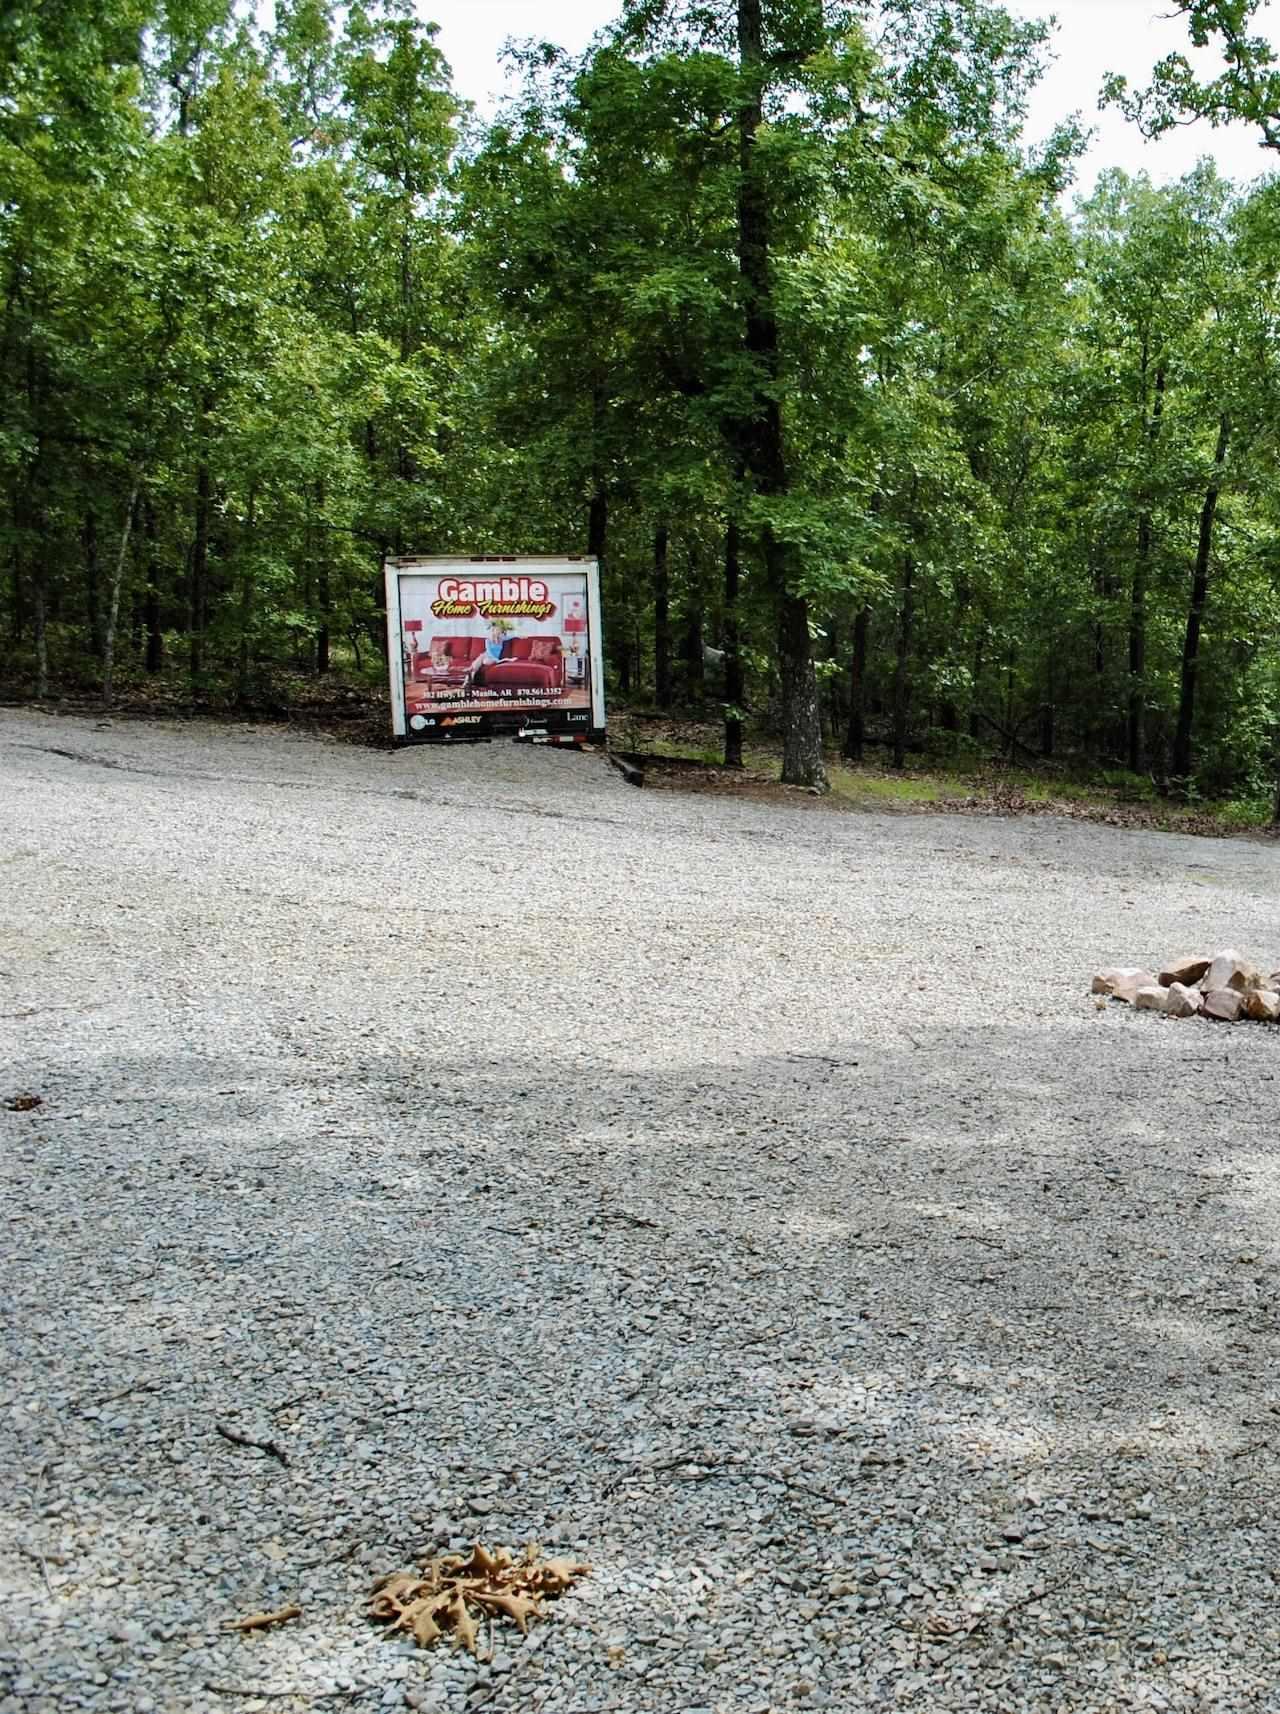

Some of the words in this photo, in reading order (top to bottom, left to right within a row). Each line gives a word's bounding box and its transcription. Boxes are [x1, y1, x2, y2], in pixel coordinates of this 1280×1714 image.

[439, 578, 546, 602] Gamble
[432, 600, 473, 617] Home
[477, 600, 553, 618] Furnishings
[500, 689, 512, 697] AR
[415, 697, 572, 711] www.gamblehomefurnishings.com
[425, 718, 436, 726] LG
[567, 711, 588, 722] Lane
